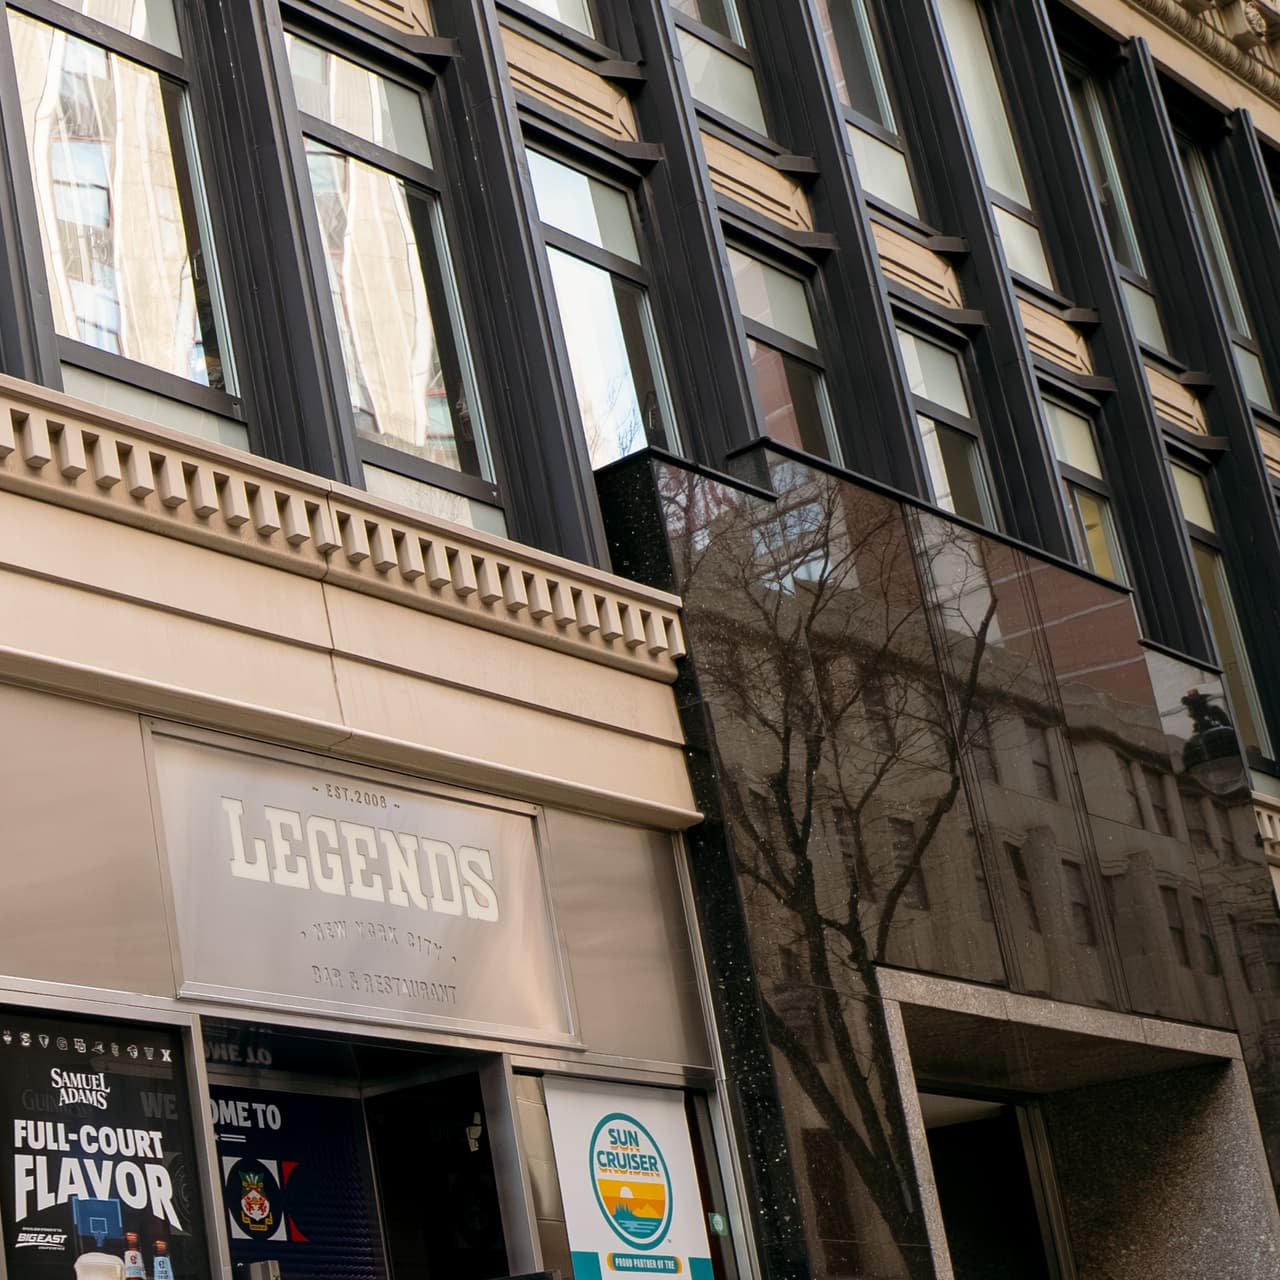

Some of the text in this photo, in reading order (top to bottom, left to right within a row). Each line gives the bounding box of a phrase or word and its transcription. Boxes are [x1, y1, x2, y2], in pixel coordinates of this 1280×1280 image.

[221, 796, 499, 922] LEGENDS
[312, 965, 342, 986] BAR
[364, 973, 457, 1005] RESTAURANT
[50, 1067, 111, 1094] SAMUEL
[59, 1088, 108, 1110] ADAMS
[252, 1102, 282, 1131] TO
[14, 1119, 164, 1159] FULL-COURT
[608, 1128, 640, 1148] SUN
[597, 1150, 659, 1172] CRUISER
[14, 1154, 183, 1232] FLAVOR
[615, 1258, 633, 1267] PROUD
